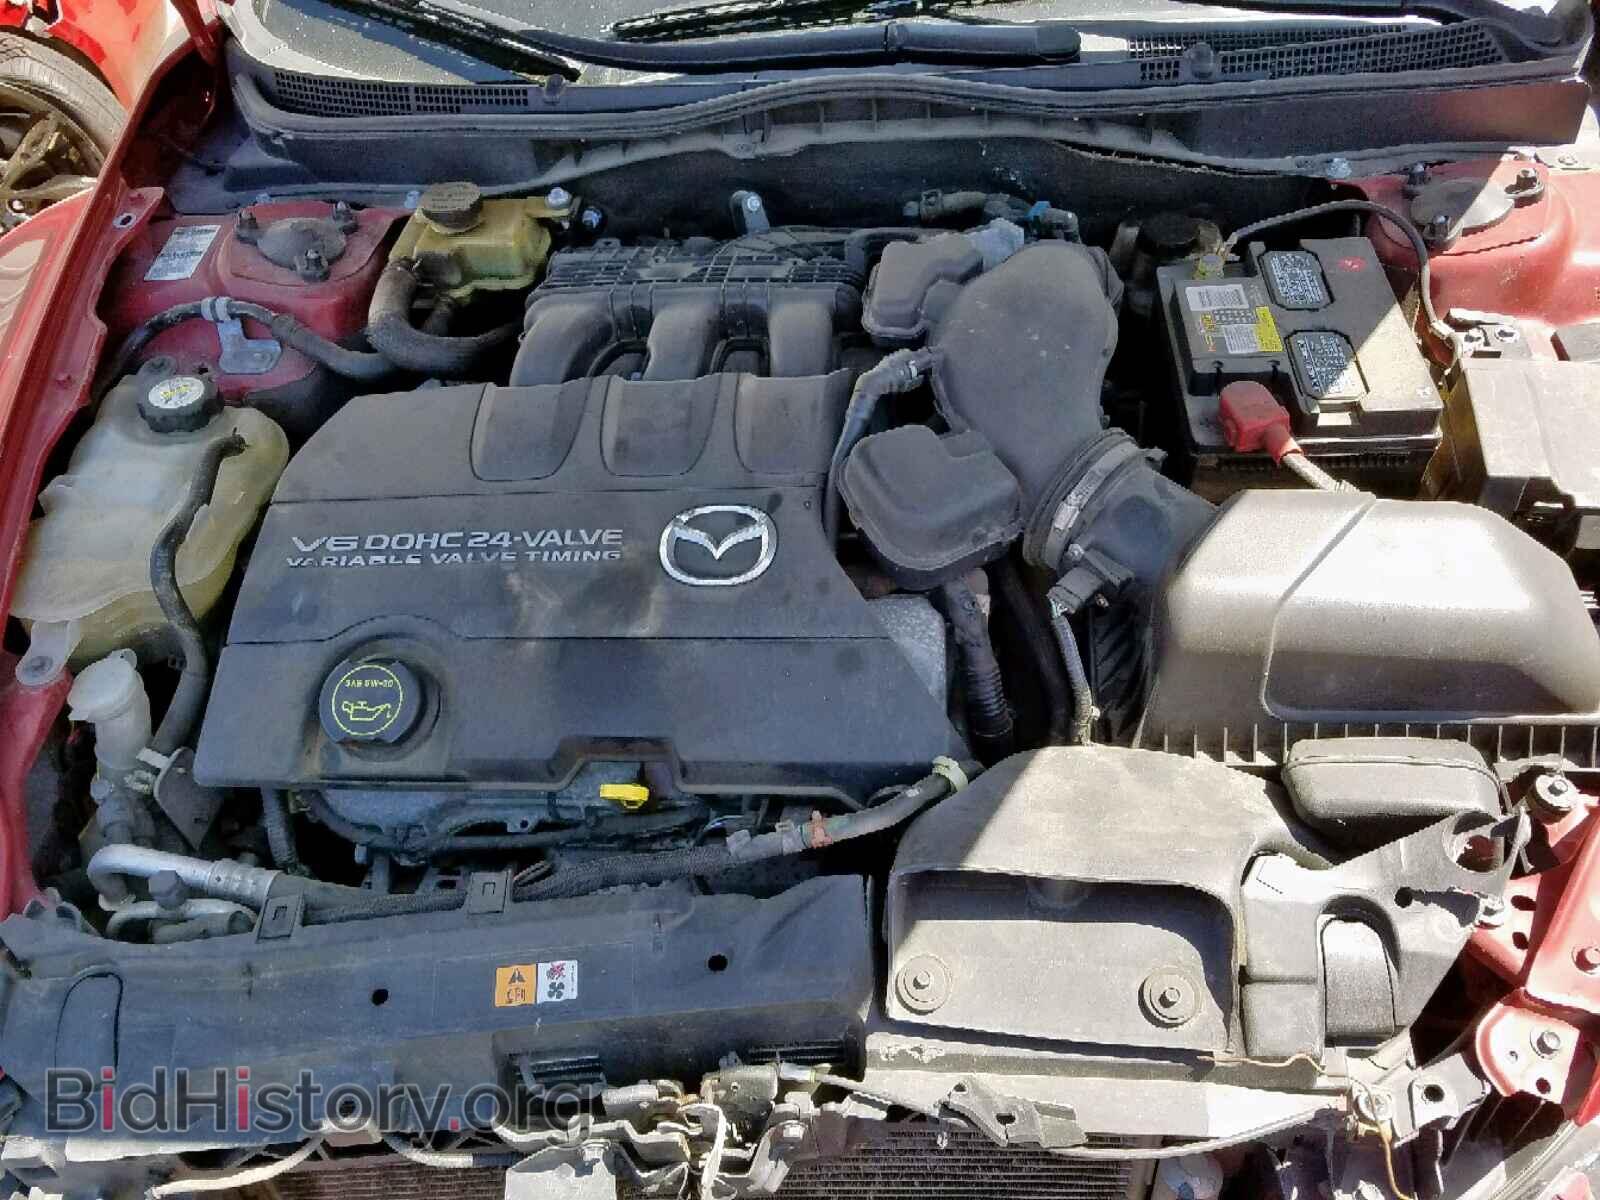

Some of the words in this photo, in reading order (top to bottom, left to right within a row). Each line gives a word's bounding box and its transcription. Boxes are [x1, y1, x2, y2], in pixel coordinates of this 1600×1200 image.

[291, 535, 358, 553] V6
[365, 531, 464, 549] DOHC
[467, 528, 623, 547] 24-VALVE
[286, 554, 421, 568] VARIABLE
[431, 552, 516, 565] VALVE
[525, 550, 621, 563] TIMING
